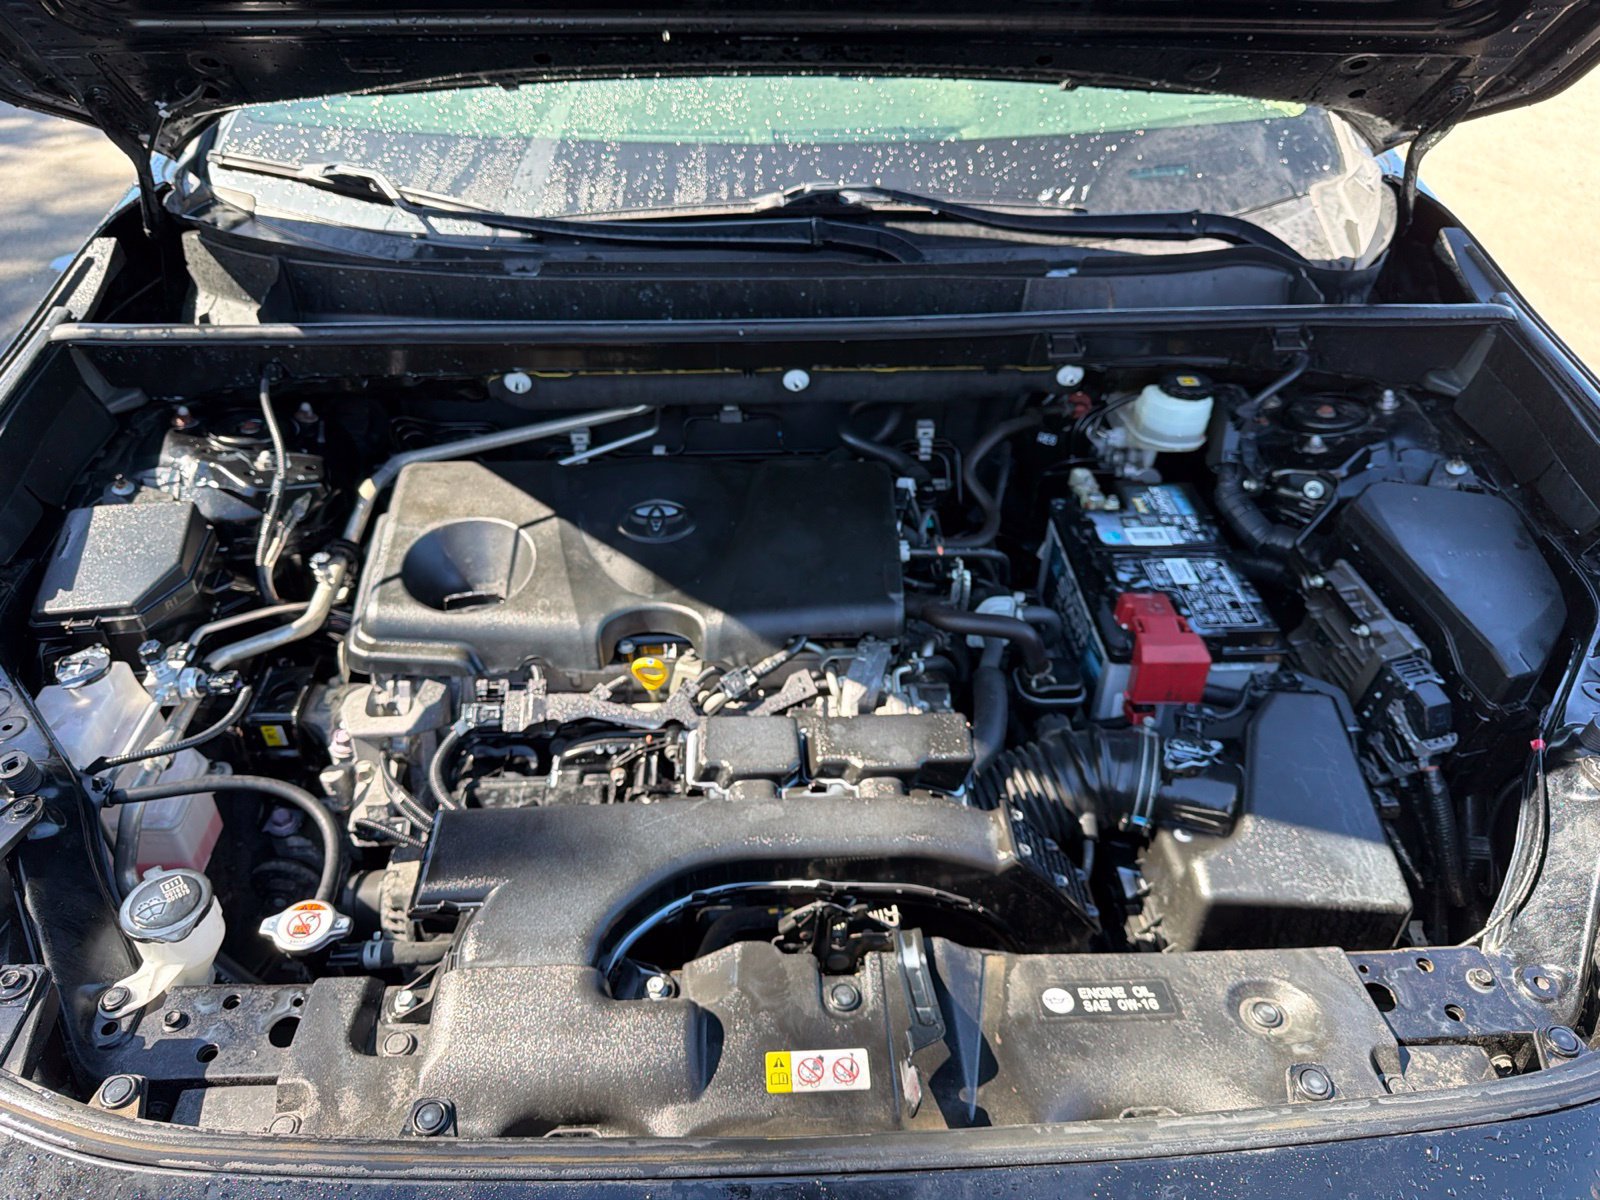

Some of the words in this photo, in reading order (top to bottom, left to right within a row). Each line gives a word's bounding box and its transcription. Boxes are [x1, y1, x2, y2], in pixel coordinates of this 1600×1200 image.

[1077, 986, 1127, 1000] ENGINE
[1131, 985, 1156, 998] OIL
[1082, 999, 1112, 1013] SAE
[1116, 998, 1160, 1011] 0W-16
